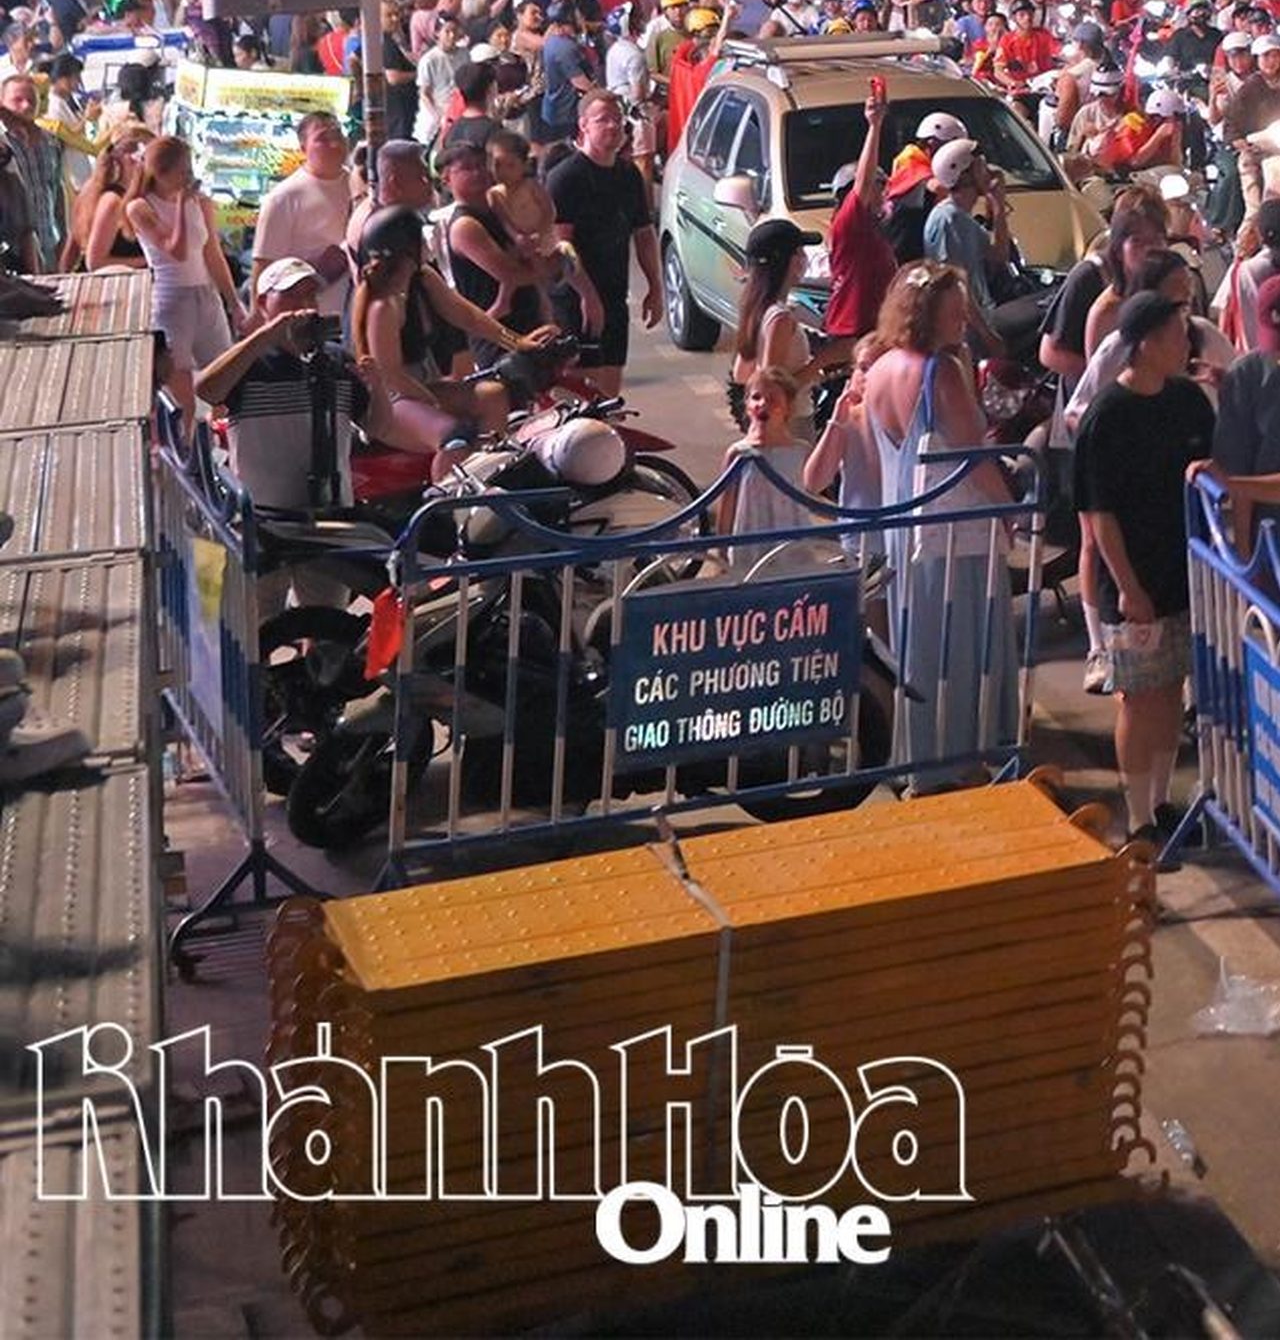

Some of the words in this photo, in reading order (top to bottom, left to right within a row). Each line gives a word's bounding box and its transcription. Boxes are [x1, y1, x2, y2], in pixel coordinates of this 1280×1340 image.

[653, 619, 706, 657] KHU
[716, 609, 766, 652] VỰC
[774, 594, 829, 641] CẤM
[635, 669, 679, 705] CÁC
[689, 660, 781, 697] PHƯƠNG
[791, 648, 838, 685] TIỆN
[624, 719, 669, 752] GIAO
[676, 708, 741, 744] THÔNG
[749, 696, 814, 734] ĐƯỜNG
[819, 689, 844, 726] BỘ
